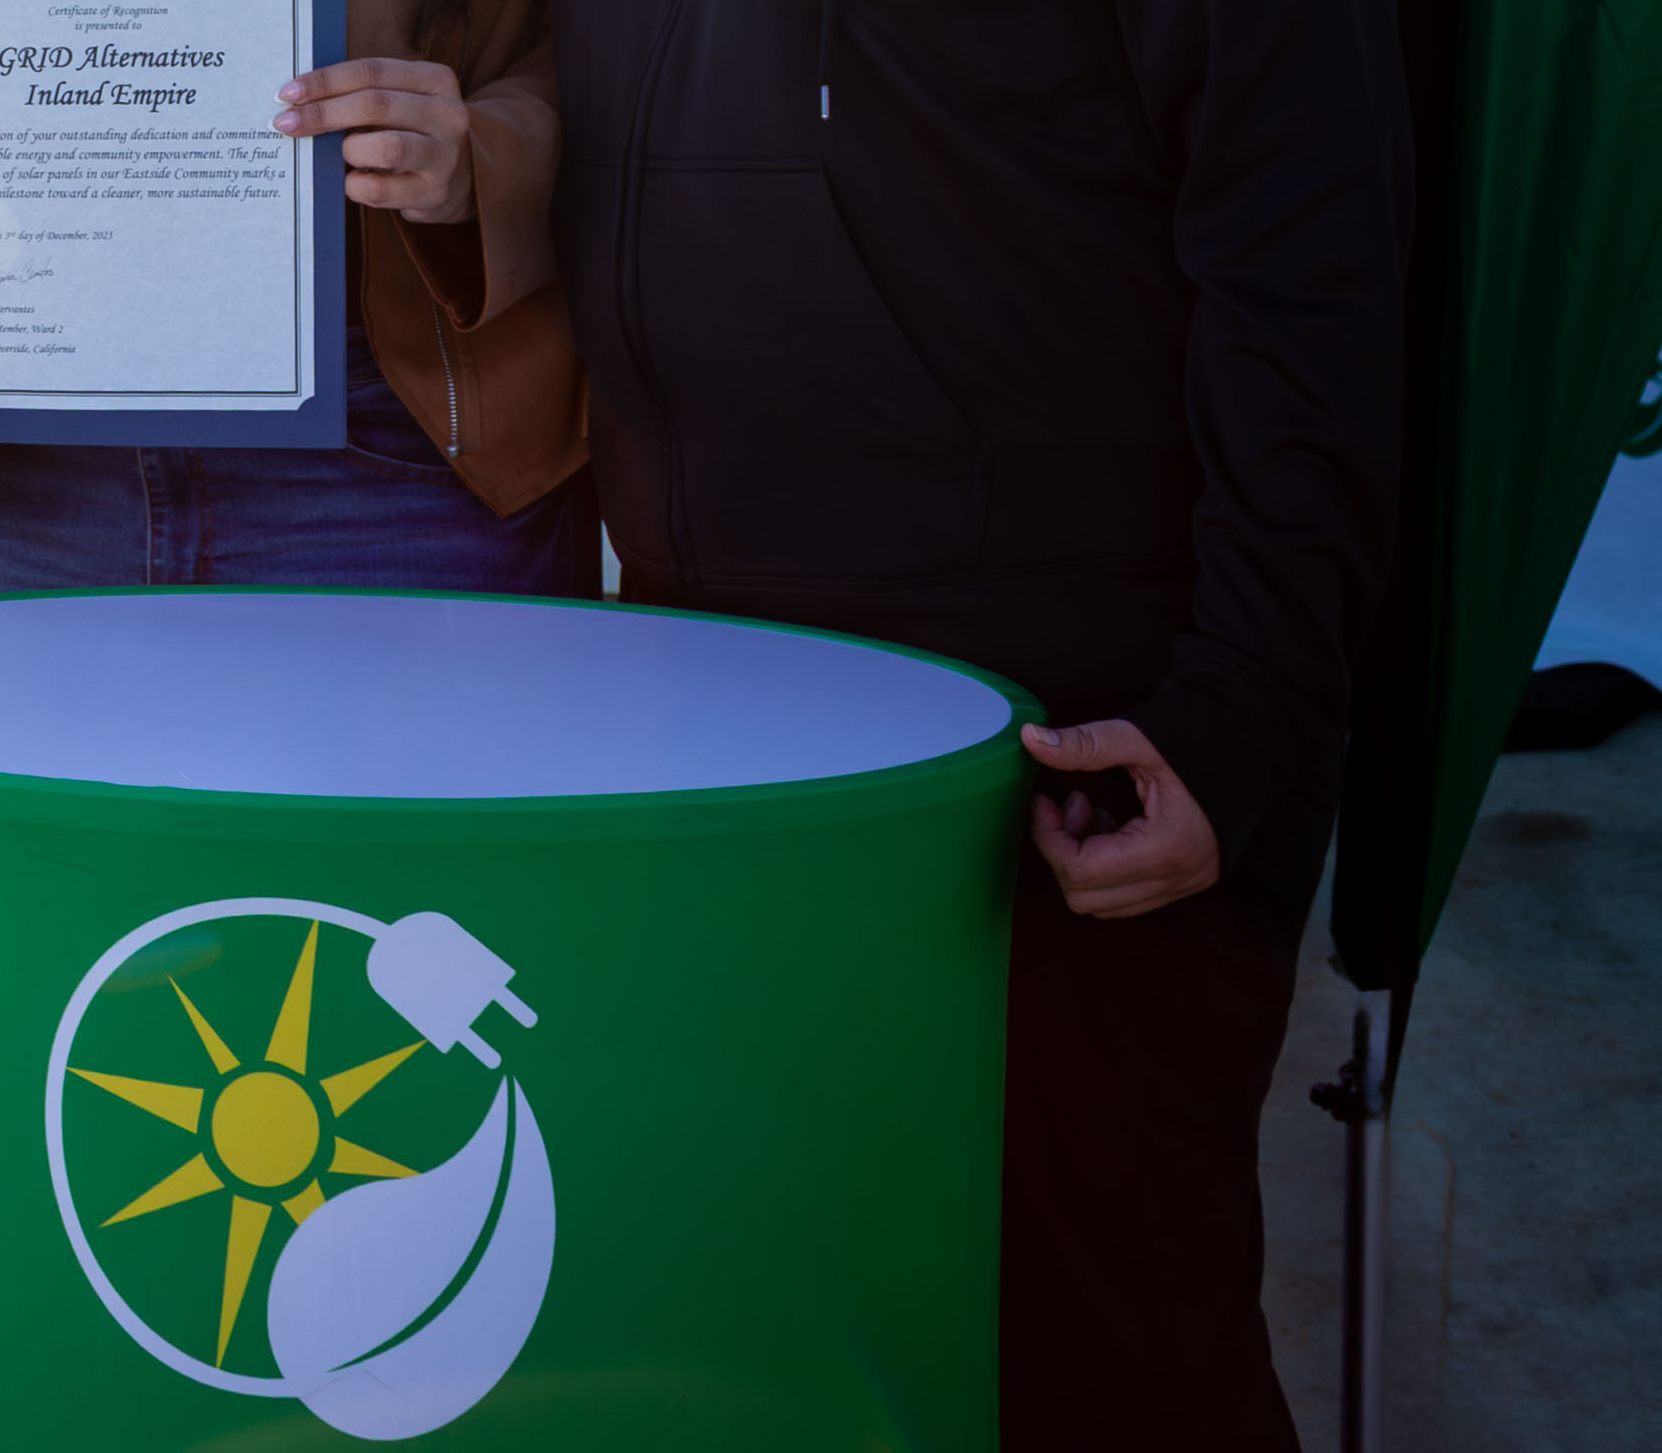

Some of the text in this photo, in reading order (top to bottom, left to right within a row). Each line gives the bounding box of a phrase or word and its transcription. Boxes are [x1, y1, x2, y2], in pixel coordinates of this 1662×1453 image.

[48, 5, 168, 18] Certificate of Recognition
[75, 19, 142, 34] is presented to
[0, 43, 225, 77] GRID Alternatives
[25, 81, 196, 113] Inland Empire
[17, 128, 33, 145] of
[30, 130, 57, 144] your
[60, 128, 128, 145] outstanding
[130, 128, 189, 141] dedication
[192, 127, 215, 141] and
[15, 151, 52, 164] energy
[55, 147, 79, 160] and
[79, 150, 141, 164] community
[143, 151, 223, 164] empowerment.
[227, 147, 248, 160] The
[249, 146, 281, 163] final
[2, 167, 18, 183] of
[18, 167, 45, 180] solar
[46, 166, 83, 183] panels
[86, 168, 97, 180] in
[100, 171, 121, 180] our
[122, 166, 171, 180] Eastside
[174, 167, 239, 182] Community
[242, 166, 276, 182] marks
[278, 171, 285, 179] a
[48, 186, 91, 199] toward
[91, 190, 98, 199] a
[101, 186, 143, 200] cleaner,
[147, 190, 174, 199] more
[177, 185, 239, 199] sustainable
[240, 185, 281, 202] future.
